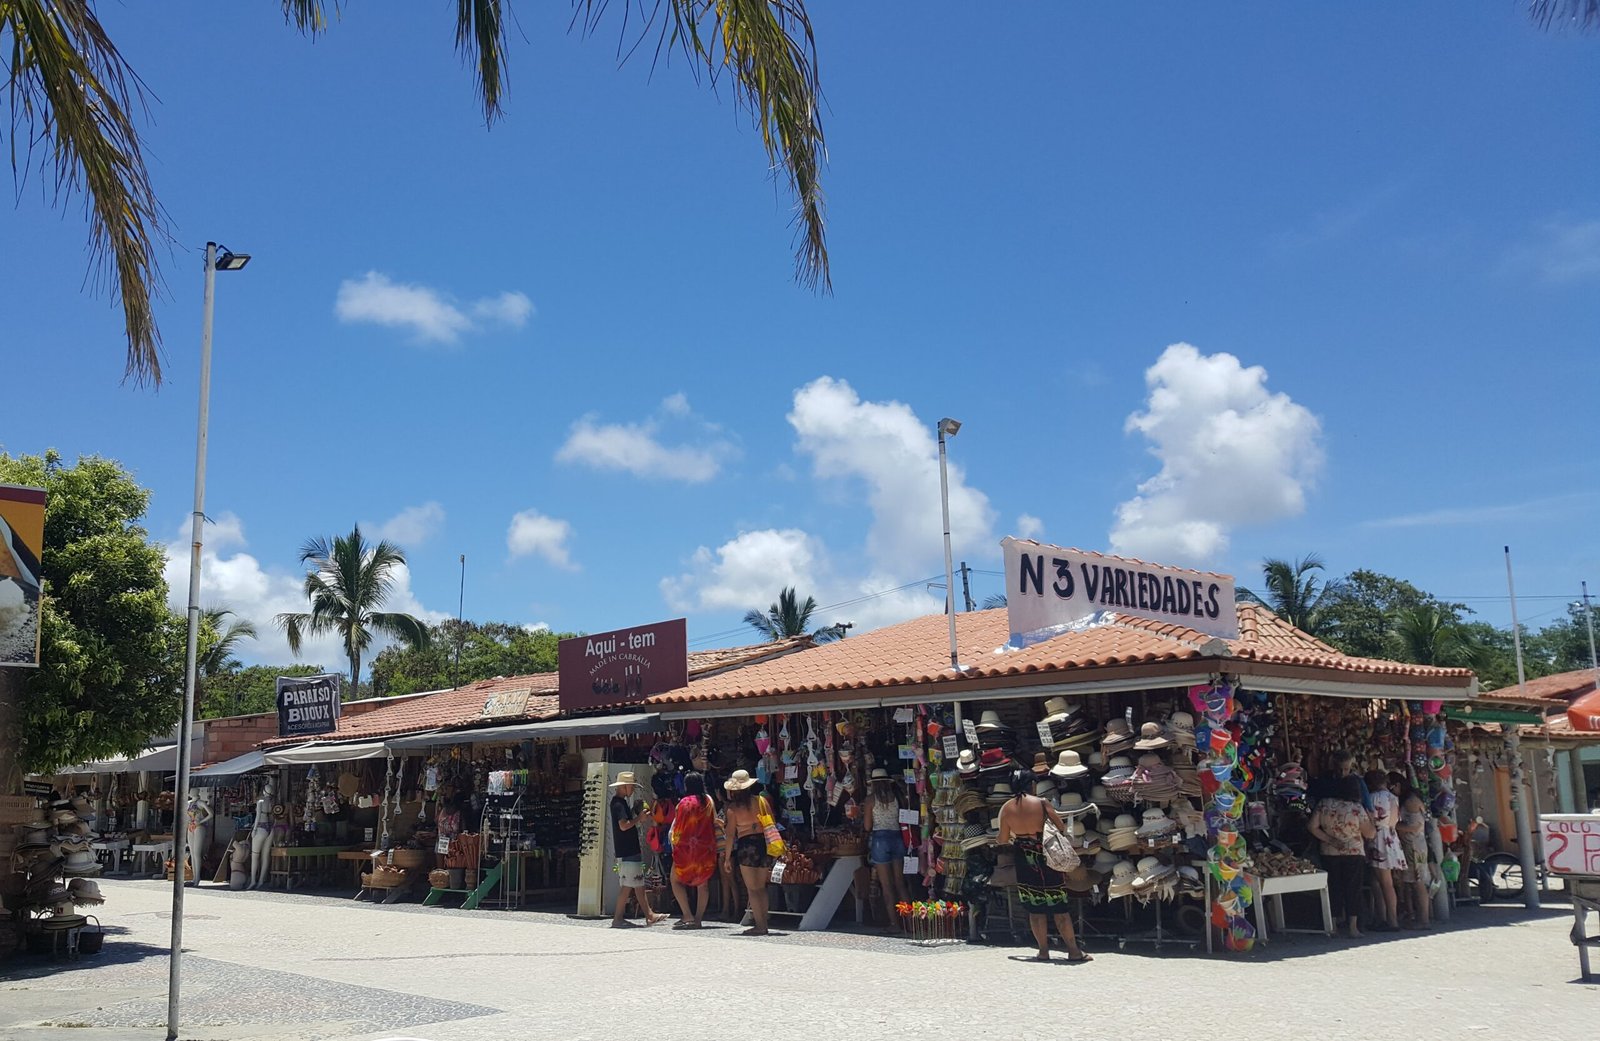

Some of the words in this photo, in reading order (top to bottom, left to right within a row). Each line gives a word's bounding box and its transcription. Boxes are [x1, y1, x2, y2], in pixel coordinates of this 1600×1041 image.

[1020, 553, 1044, 596] N
[1052, 558, 1075, 599] 3
[1081, 563, 1220, 619] VARIEDADES
[585, 635, 616, 658] Aqui
[629, 632, 655, 649] tem
[589, 658, 608, 676] MADE
[608, 655, 617, 663] IN
[288, 705, 330, 722] BIJOUX
[1547, 821, 1591, 833] COCO
[1546, 833, 1571, 872] 2
